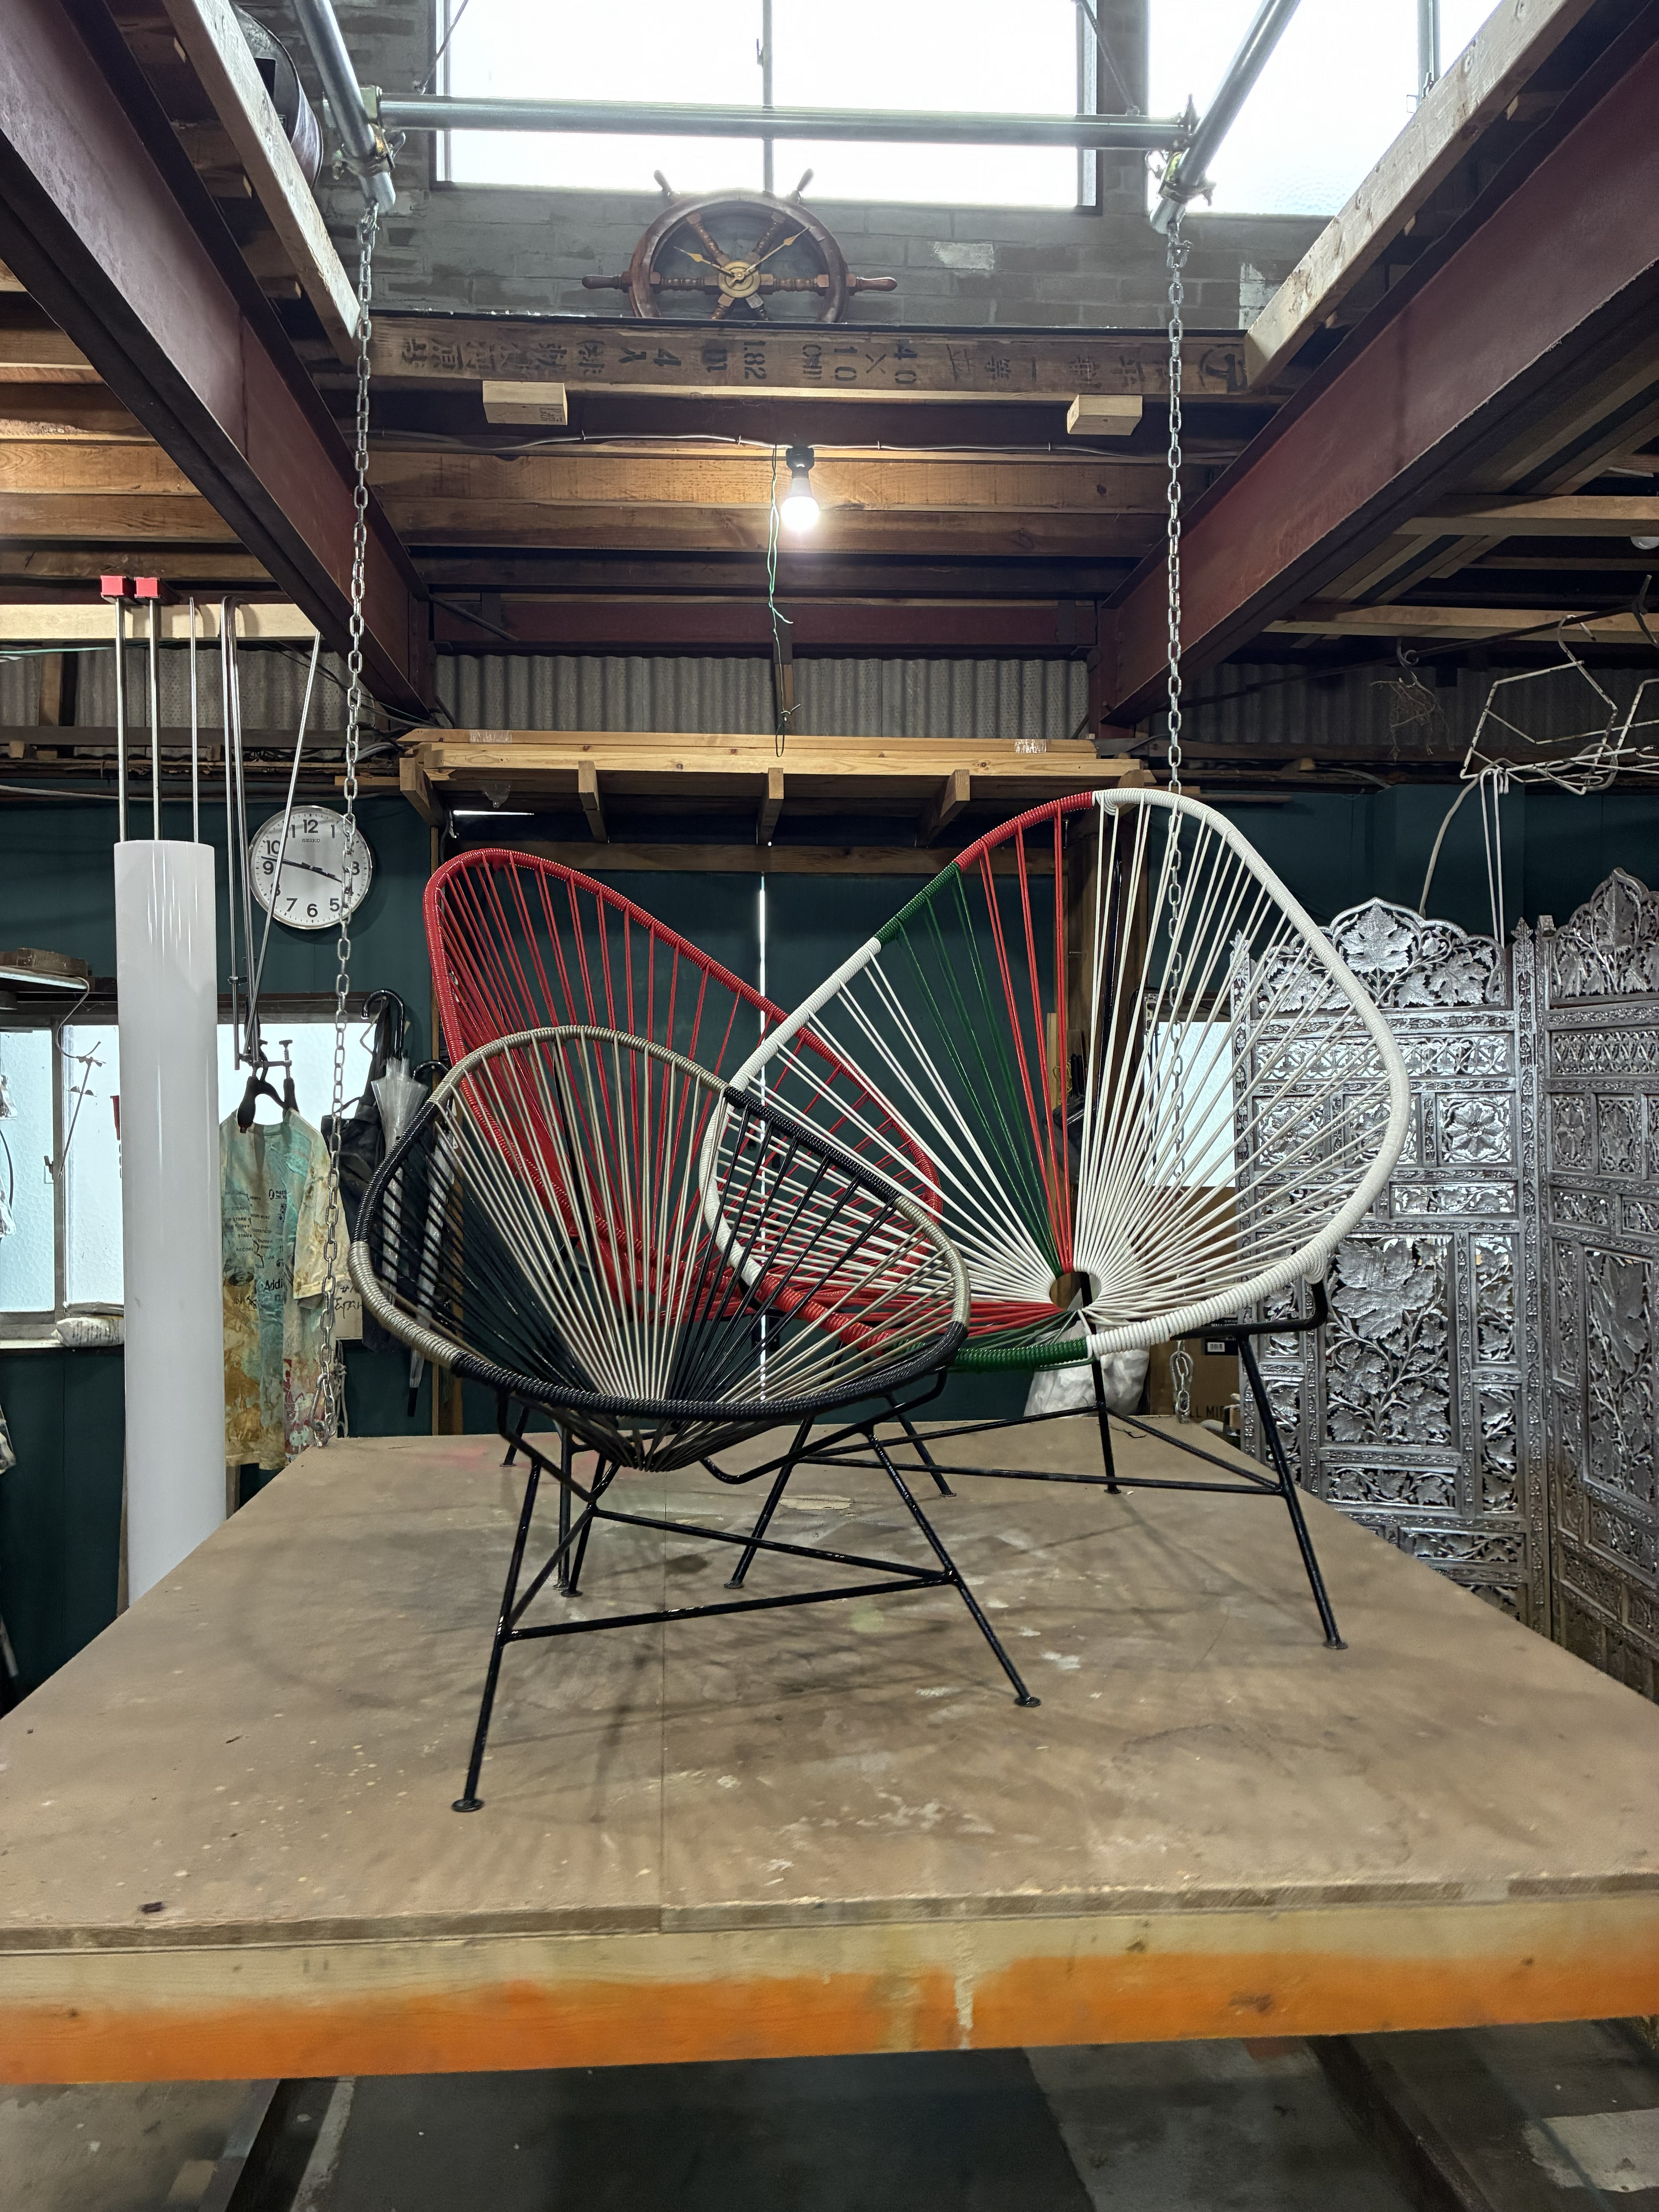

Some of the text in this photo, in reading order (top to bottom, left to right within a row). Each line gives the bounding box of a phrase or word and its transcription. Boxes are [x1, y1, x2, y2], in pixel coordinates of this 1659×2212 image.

[744, 340, 767, 380] 1.82
[303, 819, 318, 833] 12
[331, 824, 335, 838] 1
[266, 840, 280, 854] 10
[263, 861, 274, 875] 9
[352, 861, 360, 875] 3
[287, 898, 298, 912] 7
[307, 903, 318, 917] 6
[330, 898, 340, 912] 5
